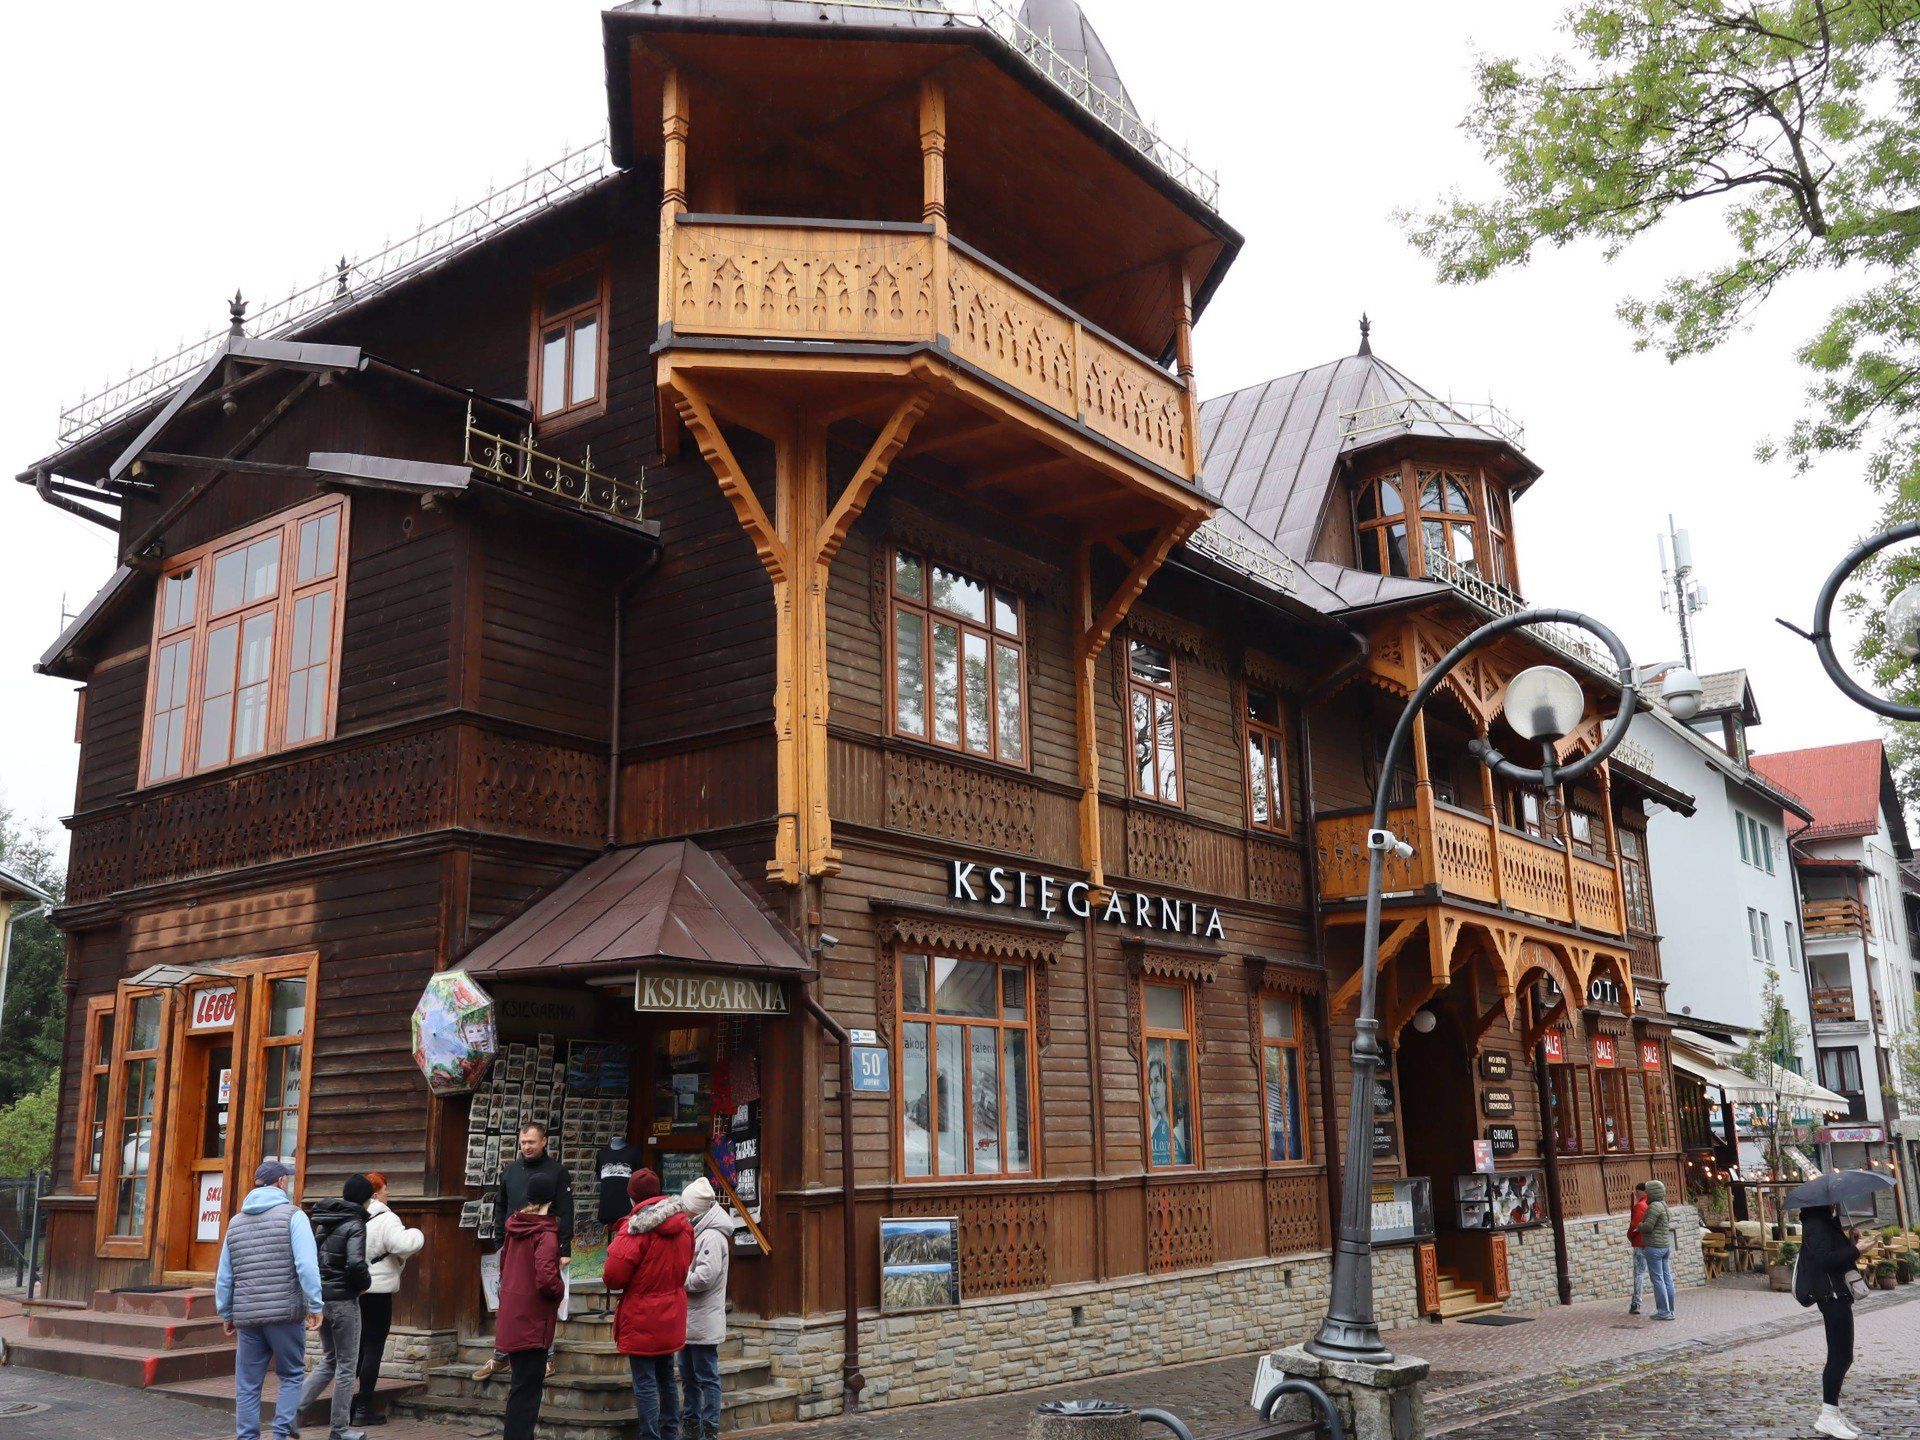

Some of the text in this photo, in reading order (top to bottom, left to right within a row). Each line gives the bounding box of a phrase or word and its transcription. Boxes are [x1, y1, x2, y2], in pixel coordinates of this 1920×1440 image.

[954, 860, 1226, 939] KSIĘGARNIA
[643, 976, 787, 1011] KSIĘGARNIA
[1585, 979, 1643, 1007] OTIA
[196, 992, 238, 1024] LEGO
[1596, 1040, 1612, 1060] SALE
[1643, 1045, 1658, 1064] SALE
[861, 1052, 880, 1076] 50
[1493, 1129, 1513, 1140] OBUWIE
